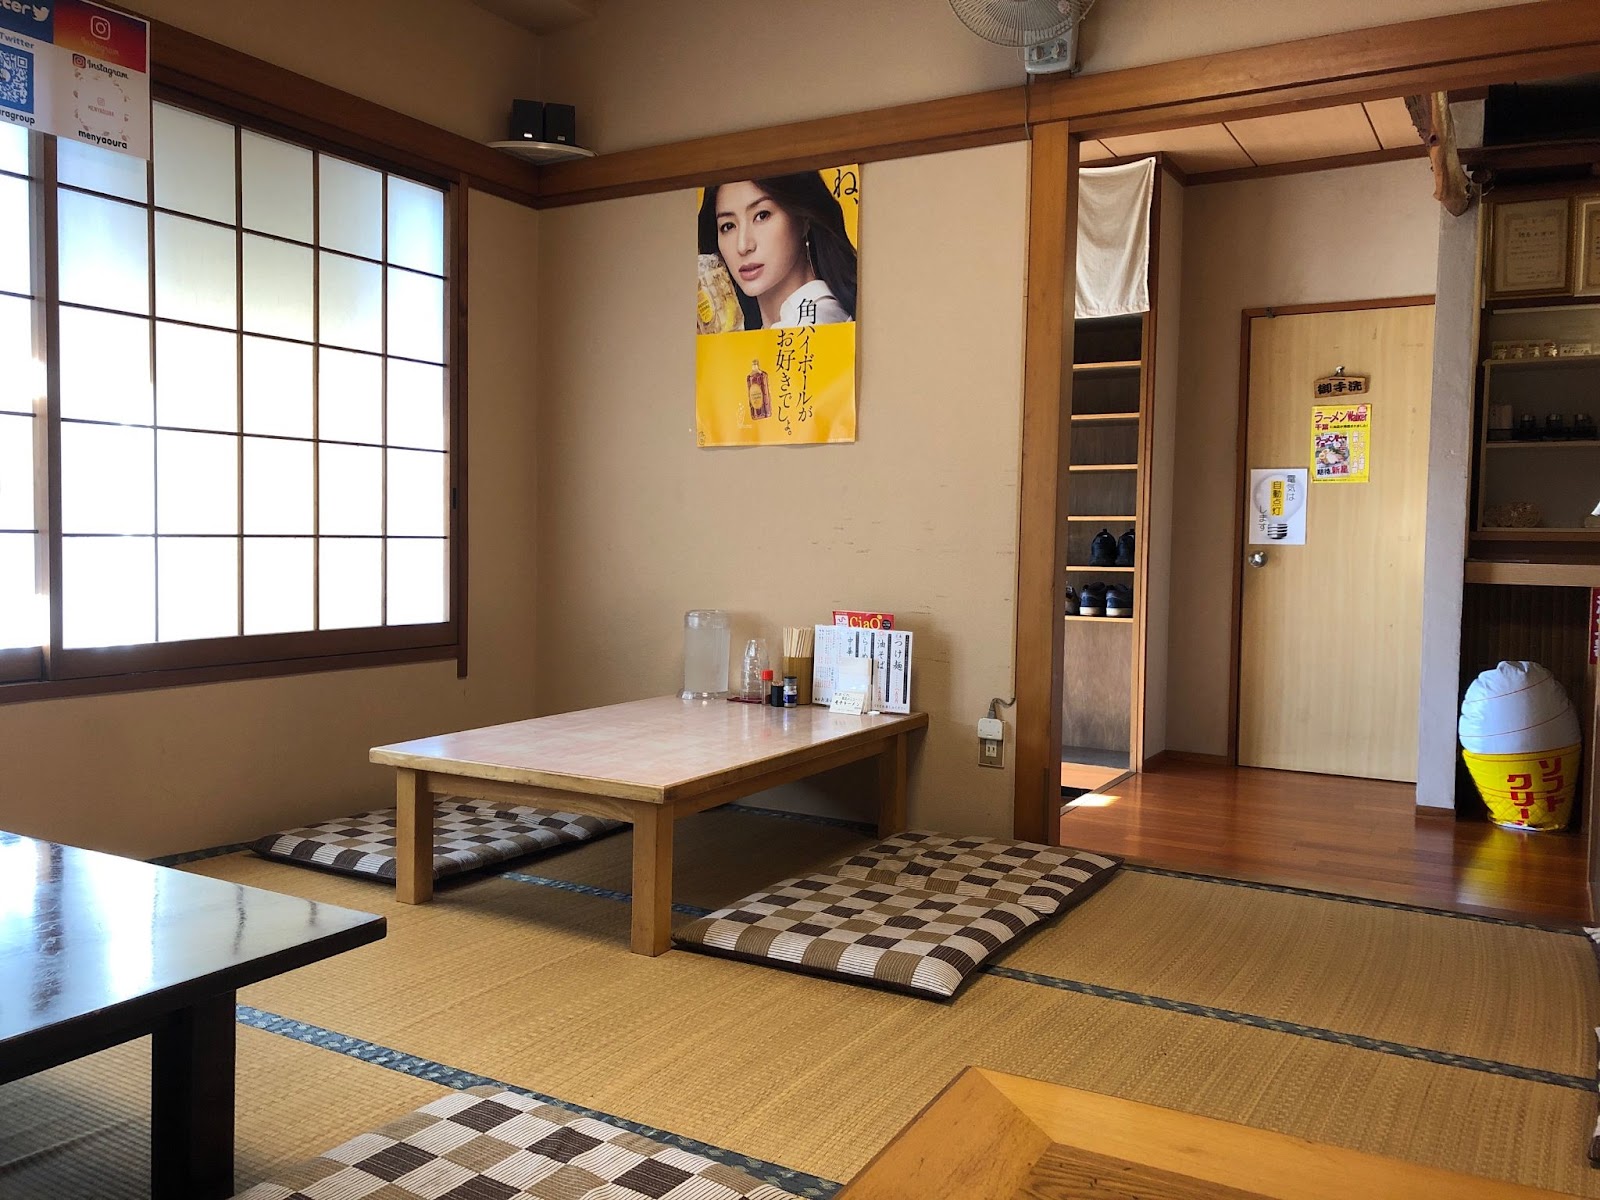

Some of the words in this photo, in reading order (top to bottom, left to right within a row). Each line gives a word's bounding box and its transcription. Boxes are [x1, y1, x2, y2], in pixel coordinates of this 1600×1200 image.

[0, 0, 31, 15] ter
[87, 59, 129, 80] Instagram
[0, 109, 35, 126] ragroup
[78, 129, 128, 149] menyaoura
[796, 298, 817, 421] 角ハイボールが
[776, 329, 796, 436] お好きでしょ。
[1317, 380, 1363, 395] 御手洗
[1271, 481, 1282, 516] 自動点灯
[877, 639, 886, 670] 油そば
[893, 640, 903, 671] つけ麺
[1538, 757, 1565, 812] ソフト
